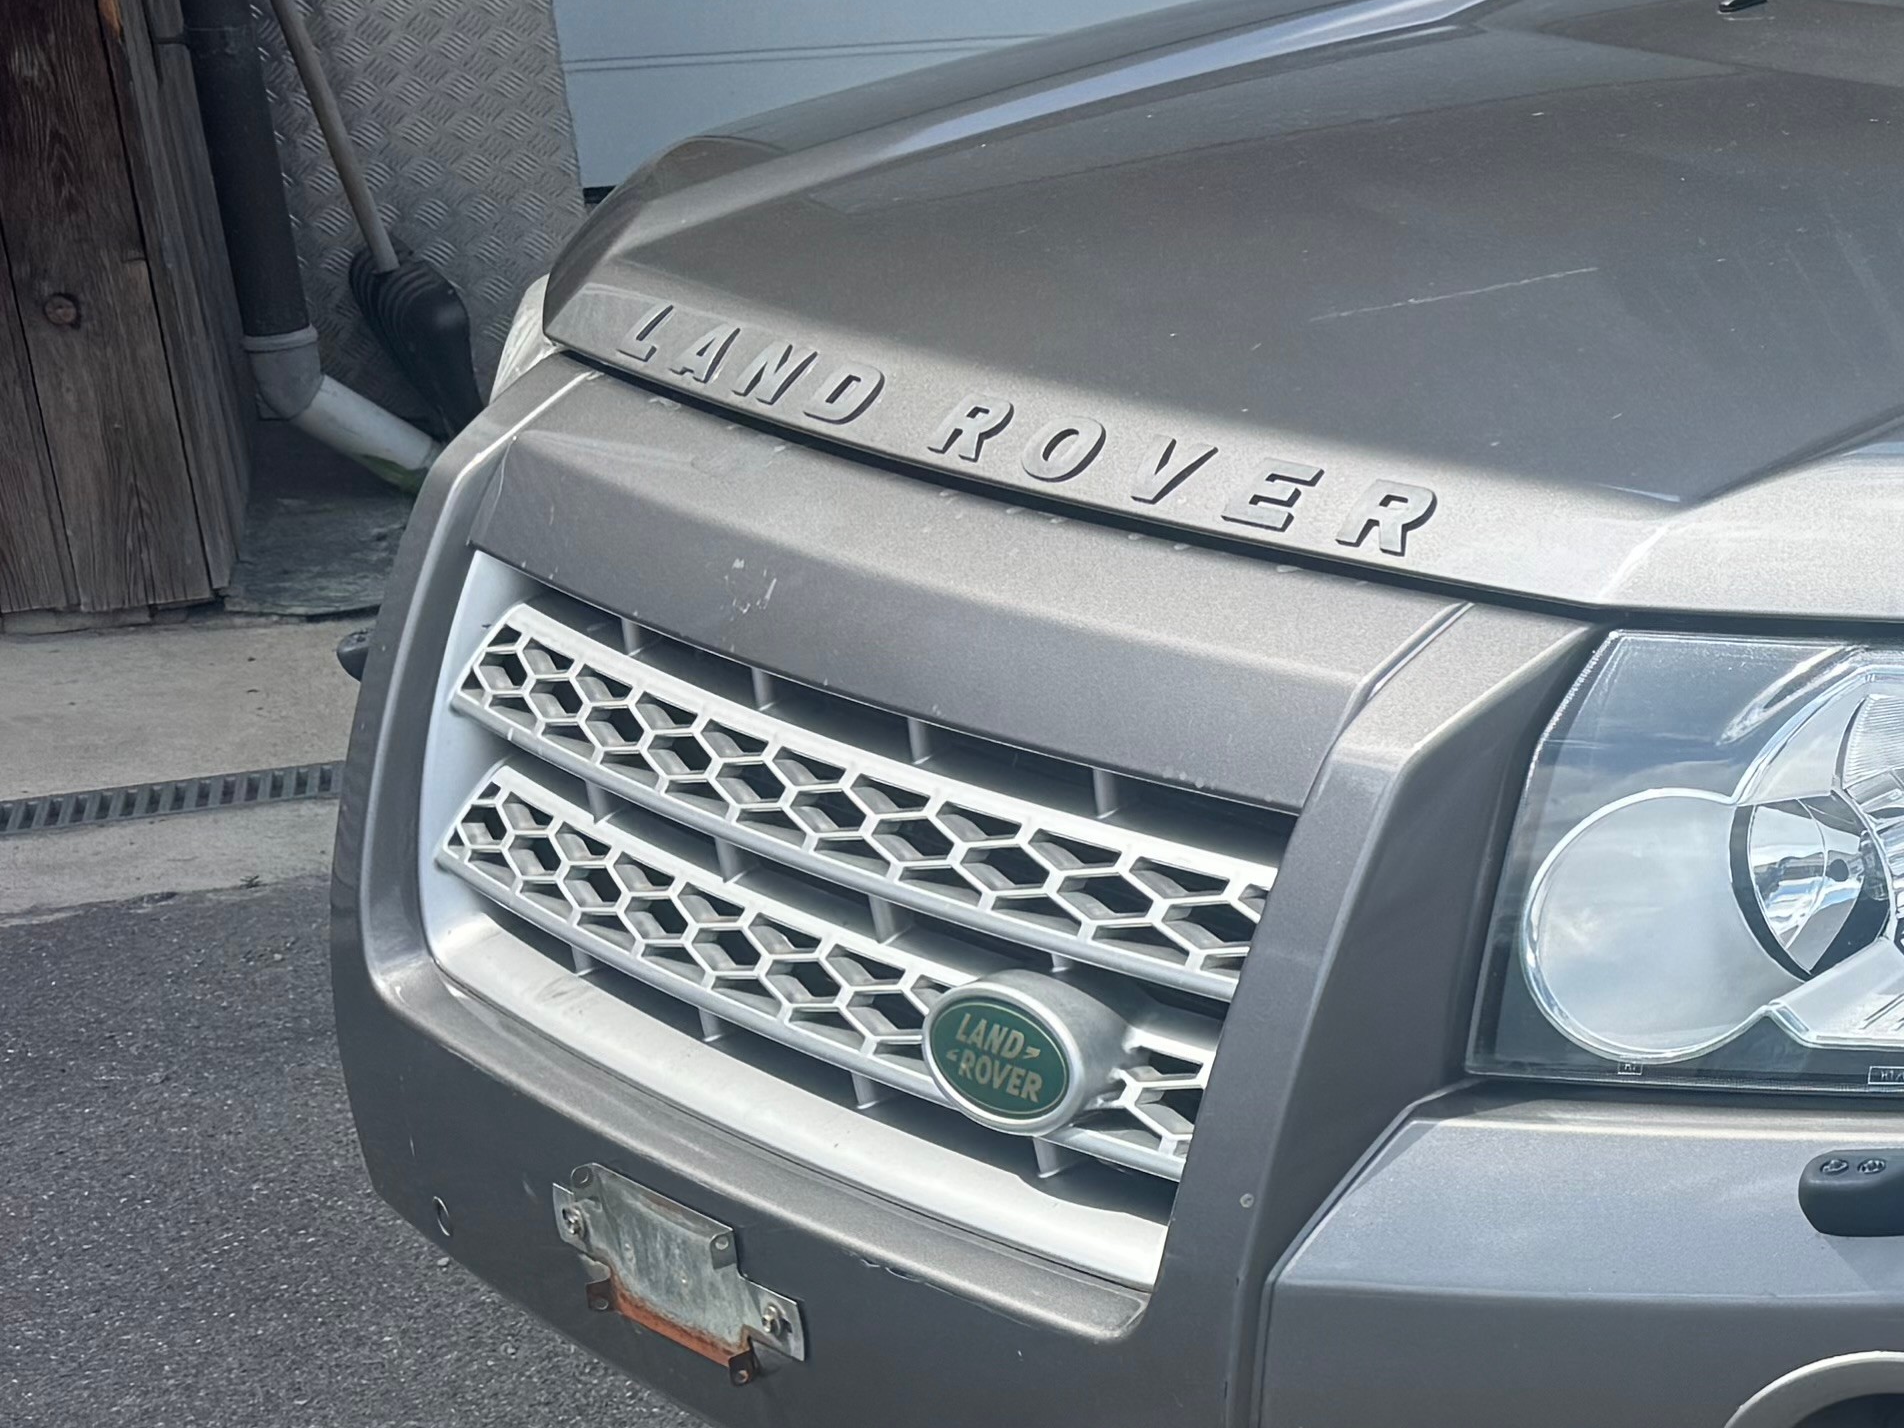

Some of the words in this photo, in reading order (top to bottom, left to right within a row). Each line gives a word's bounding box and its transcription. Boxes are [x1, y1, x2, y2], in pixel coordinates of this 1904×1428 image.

[616, 304, 885, 424] LAND
[927, 394, 1438, 557] ROVER
[955, 1012, 1025, 1060] LAND
[958, 1049, 1043, 1104] ROVER
